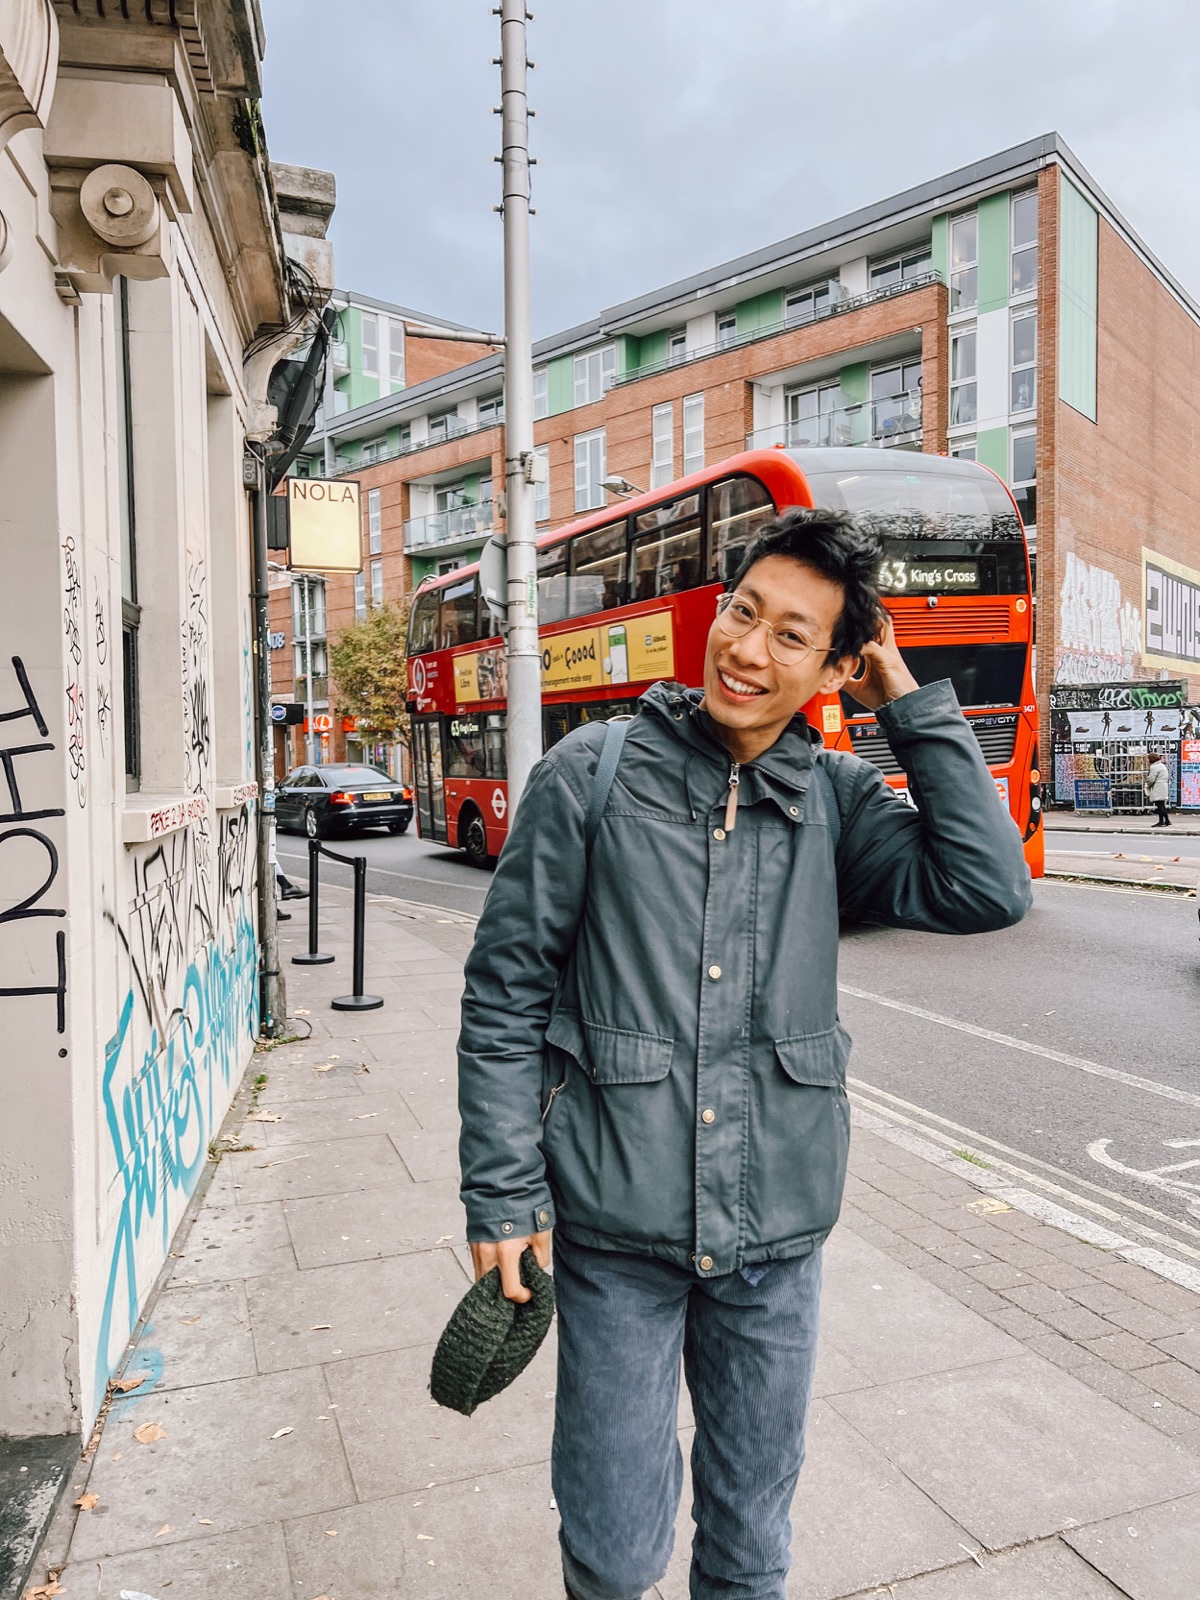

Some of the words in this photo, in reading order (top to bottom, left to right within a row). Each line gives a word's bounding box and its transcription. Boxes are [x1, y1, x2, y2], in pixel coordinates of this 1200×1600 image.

[293, 482, 355, 503] NOLA
[911, 569, 942, 585] King's
[944, 569, 976, 582] Cross
[544, 677, 569, 687] management
[1023, 705, 1035, 713] 3421
[451, 720, 459, 736] 63
